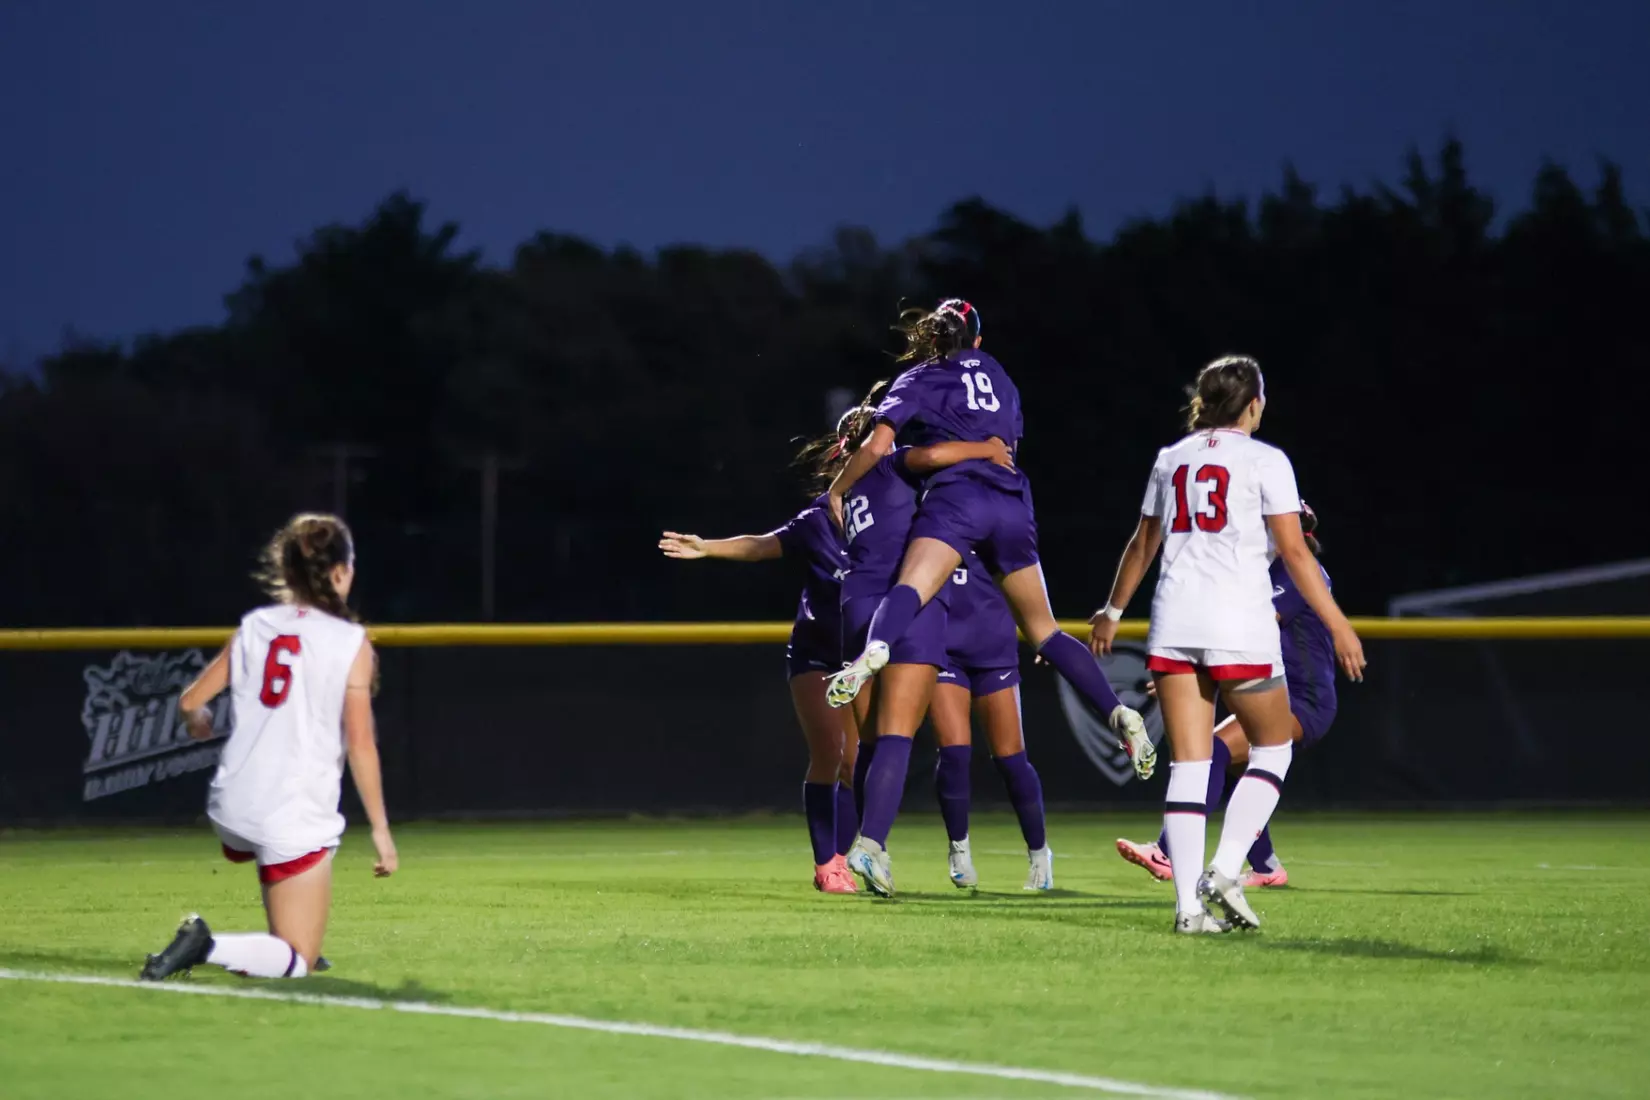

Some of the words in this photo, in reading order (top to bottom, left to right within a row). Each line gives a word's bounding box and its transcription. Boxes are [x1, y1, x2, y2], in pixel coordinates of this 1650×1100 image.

[961, 372, 1001, 413] 19
[843, 495, 875, 545] 22
[1171, 464, 1231, 533] 13
[259, 634, 302, 709] 6
